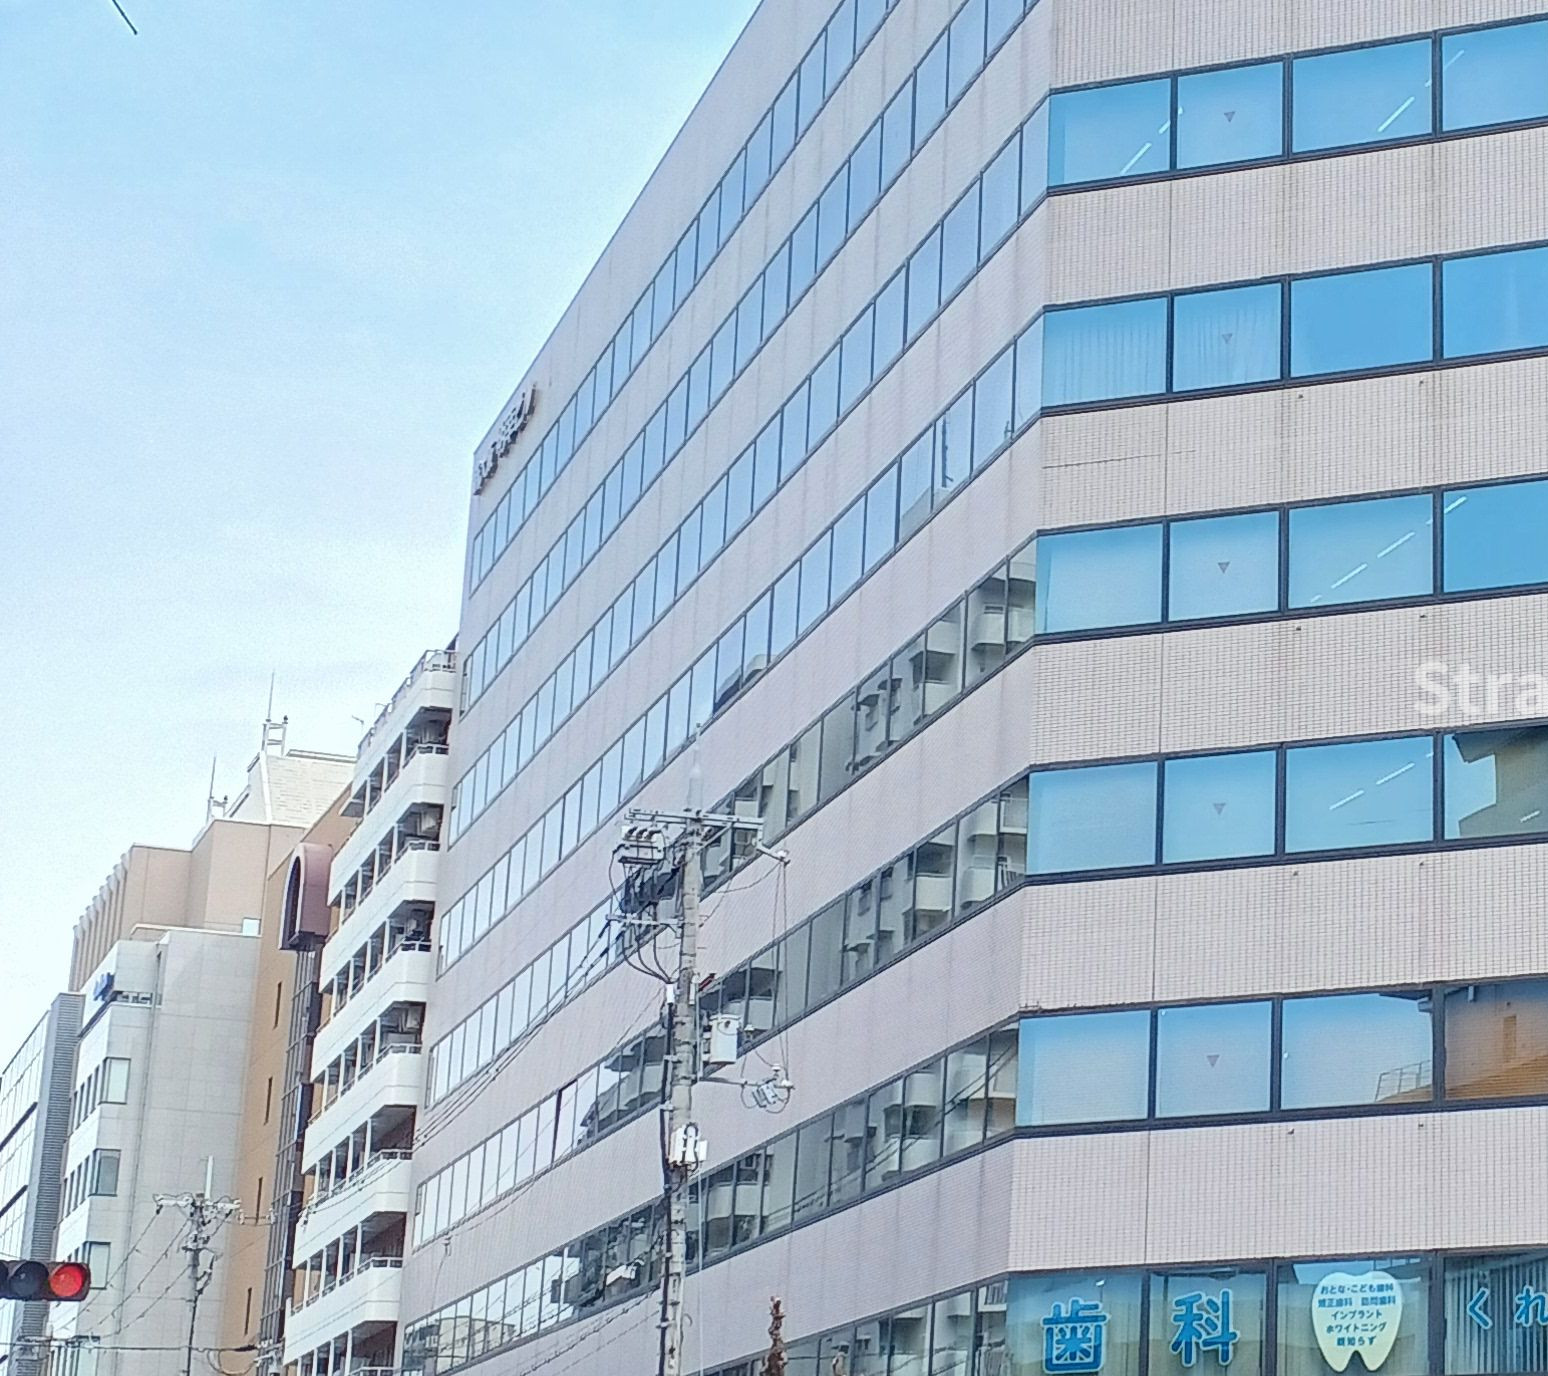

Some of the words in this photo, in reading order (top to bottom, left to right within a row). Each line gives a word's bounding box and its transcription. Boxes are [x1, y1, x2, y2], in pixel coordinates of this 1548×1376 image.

[1331, 1309, 1382, 1321] インプラント
[1326, 1321, 1388, 1334] ホワイトニング
